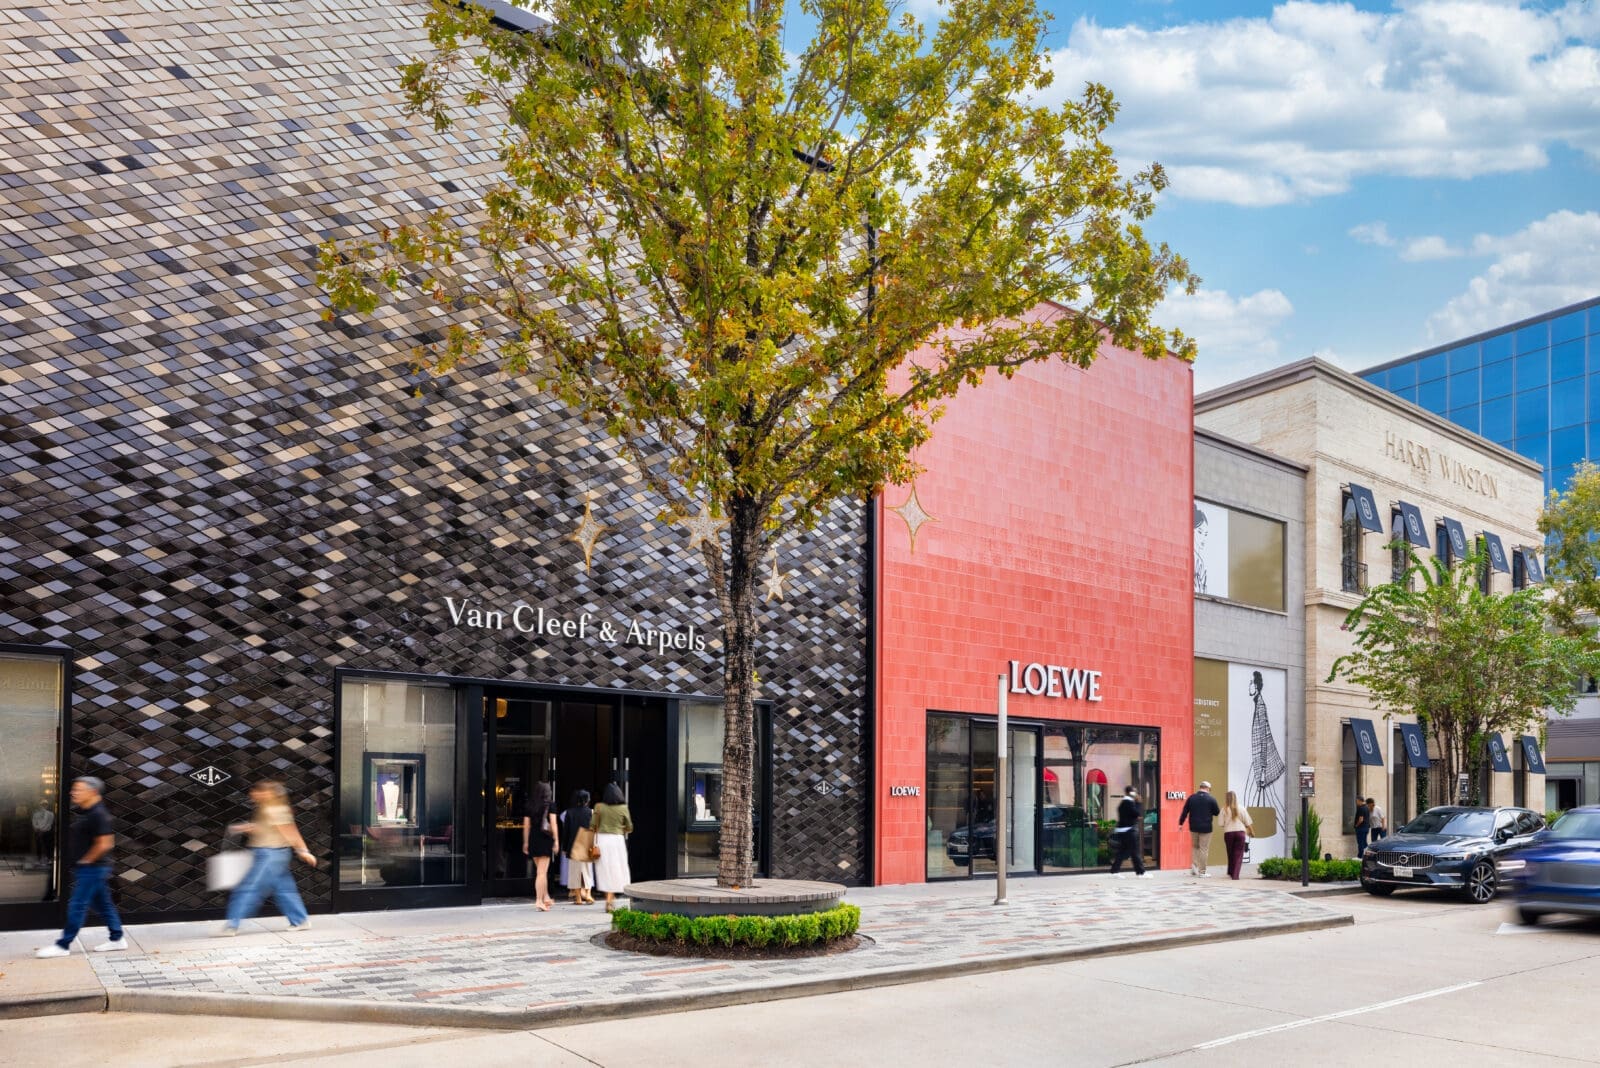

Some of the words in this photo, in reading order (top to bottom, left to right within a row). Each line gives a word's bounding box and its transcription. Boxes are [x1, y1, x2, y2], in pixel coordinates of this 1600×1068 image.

[1385, 430, 1432, 473] HARRY
[1439, 453, 1498, 499] WINSTON
[443, 596, 503, 630] Van
[512, 604, 593, 639] Cleef
[598, 621, 618, 643] &
[625, 619, 706, 655] Arpels
[1009, 660, 1103, 702] LOEWE
[890, 786, 921, 797] LOEWE
[1167, 791, 1187, 800] LOEWE
